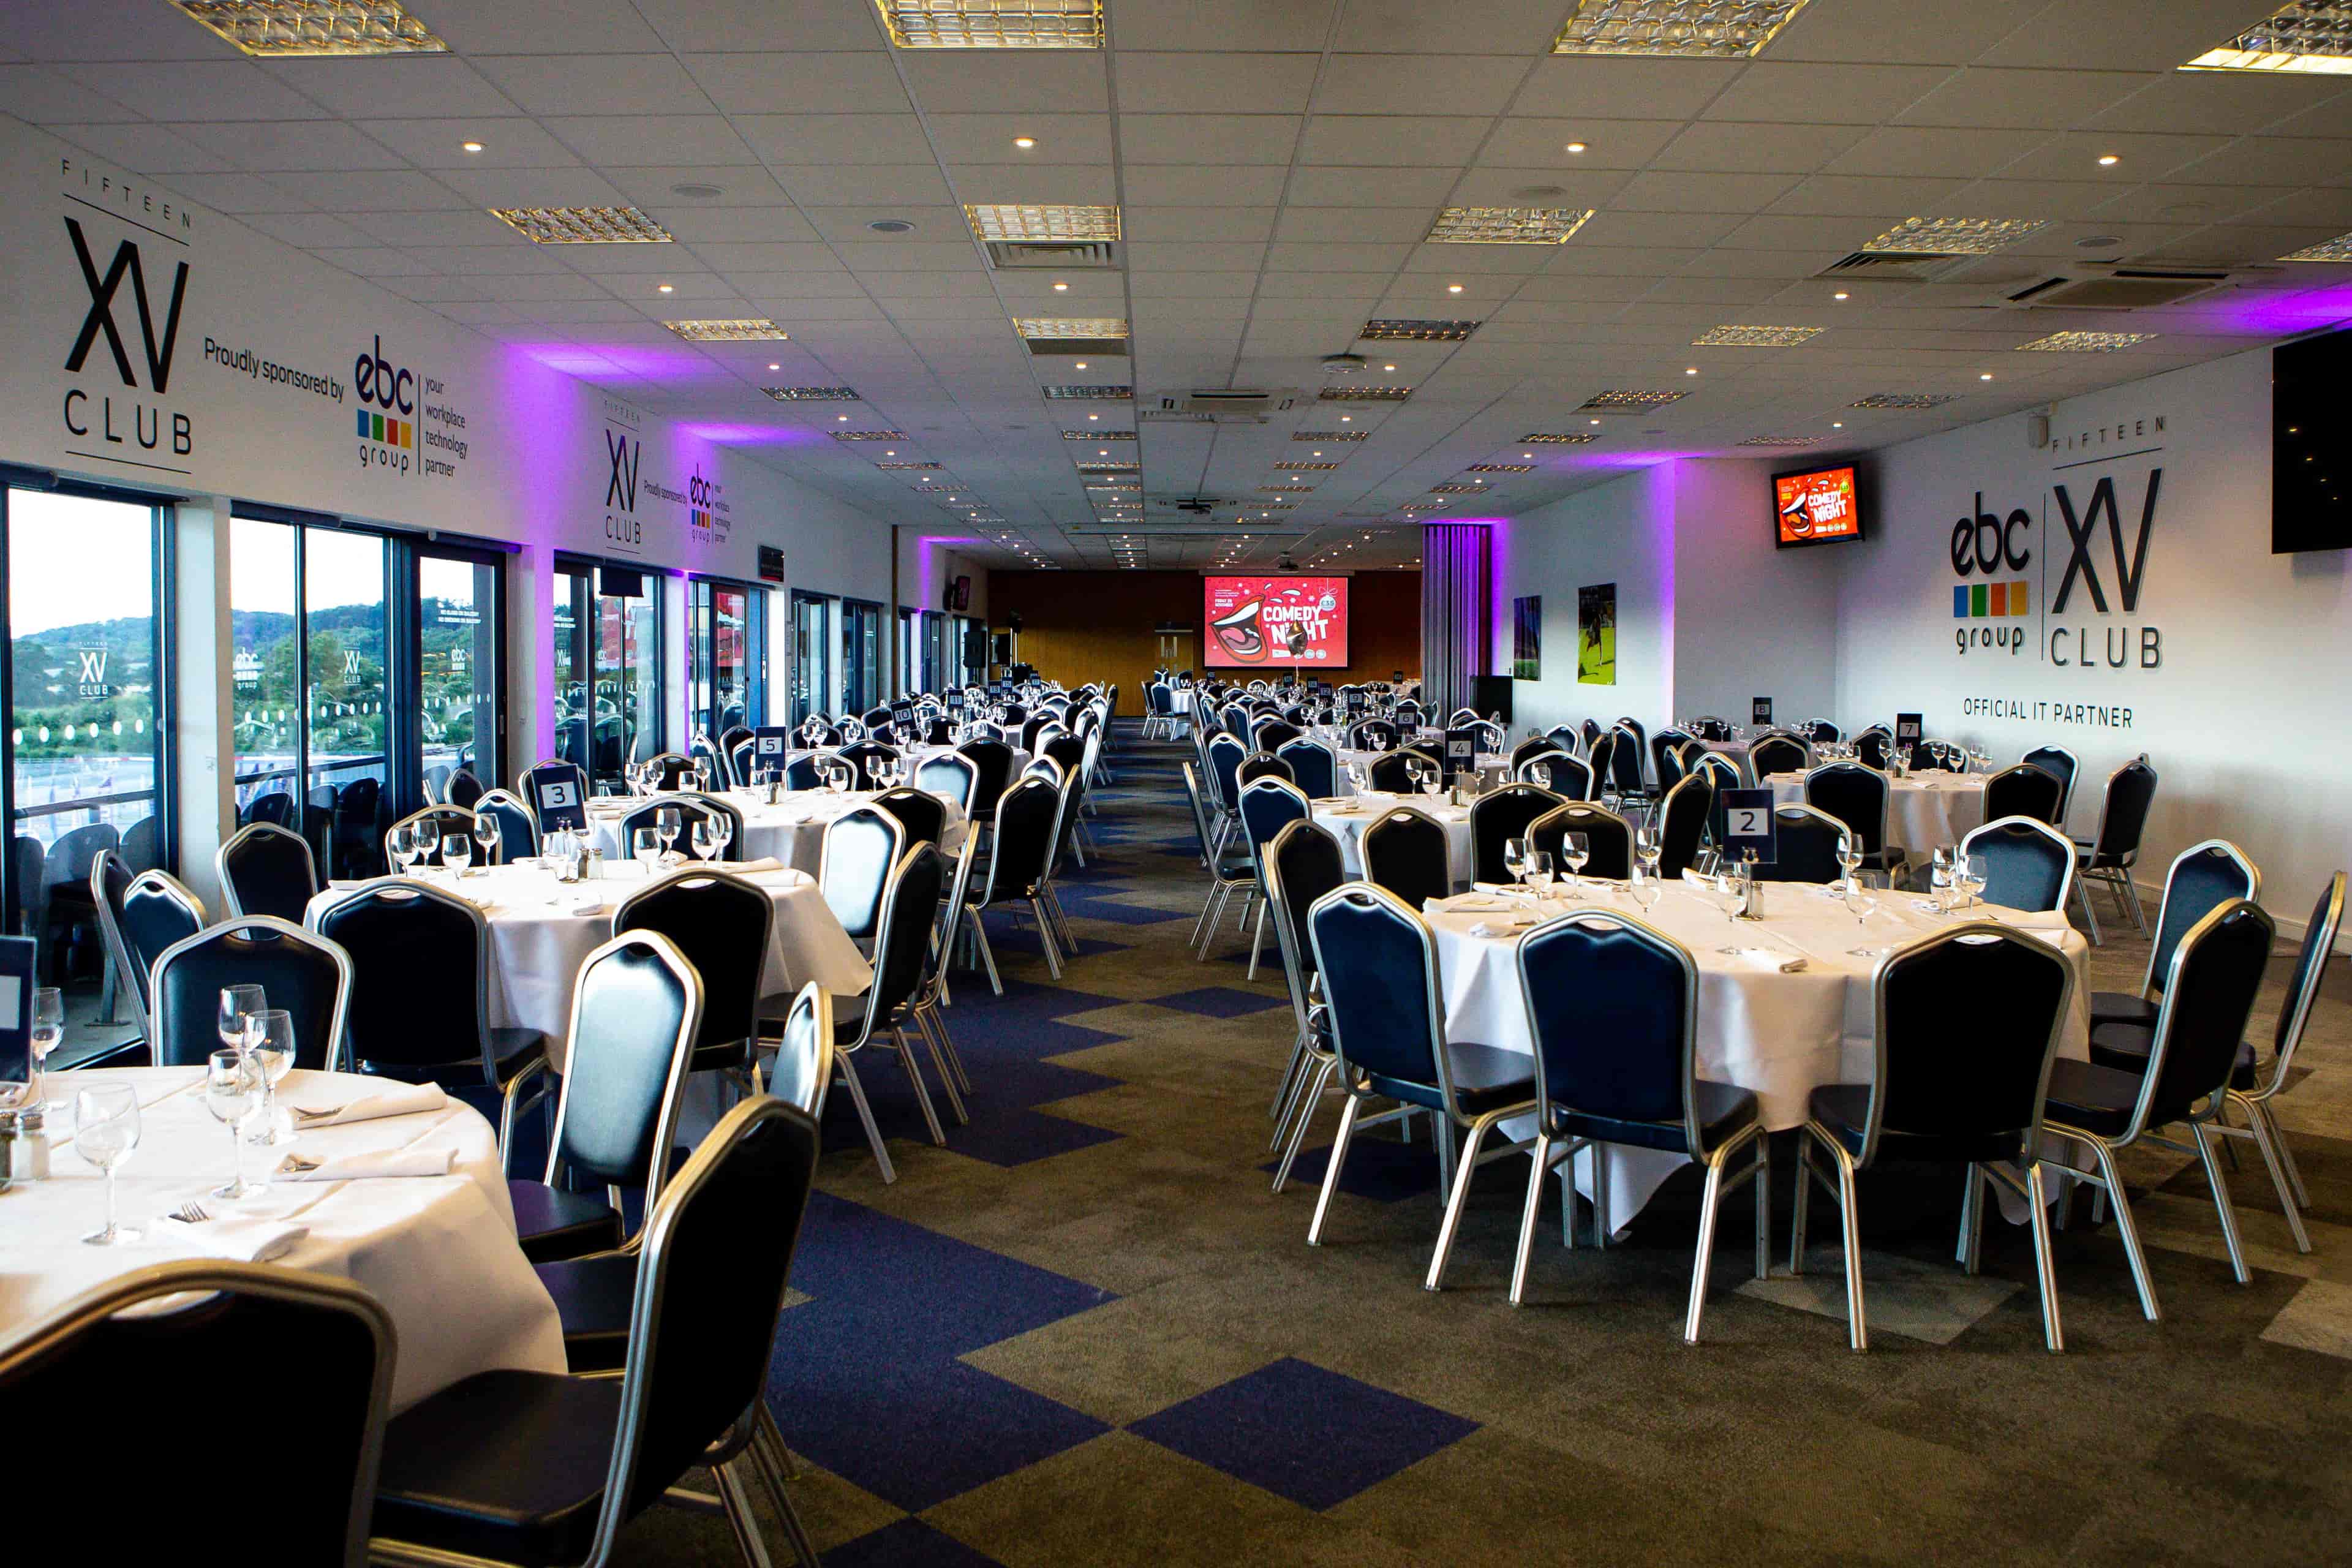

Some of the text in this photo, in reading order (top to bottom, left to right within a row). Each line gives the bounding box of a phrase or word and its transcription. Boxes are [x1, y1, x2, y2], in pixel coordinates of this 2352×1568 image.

[62, 159, 190, 228] FIFTEEN
[64, 216, 189, 394] XV
[205, 337, 344, 404] Proudly sponsored by
[355, 334, 413, 415] ebc
[425, 376, 444, 395] your
[64, 390, 191, 455] CLUB
[425, 403, 466, 429] workplace
[425, 430, 468, 459] technology
[2052, 417, 2164, 453] FIFTEEN
[360, 445, 409, 476] group
[425, 457, 455, 478] partner
[606, 429, 639, 513] XV
[690, 462, 710, 508] ebc
[1808, 490, 1841, 507] COMEDY
[606, 515, 641, 544] CLUB
[692, 529, 710, 545] group
[1951, 491, 2030, 576] ebc
[2051, 468, 2162, 614] XV
[1263, 604, 1322, 622] COMEDY
[1956, 627, 2023, 655] group
[2051, 627, 2161, 668] CLUB
[80, 652, 108, 682] XV
[344, 650, 360, 674] XV
[80, 685, 108, 695] CLUB
[897, 710, 909, 721] 10
[1964, 698, 2132, 728] OFFICIAL IT PARTNER
[1905, 725, 1912, 735] 7
[766, 739, 775, 751] 5
[1455, 743, 1465, 755] 4
[551, 786, 565, 804] 3
[1740, 812, 1755, 831] 2
